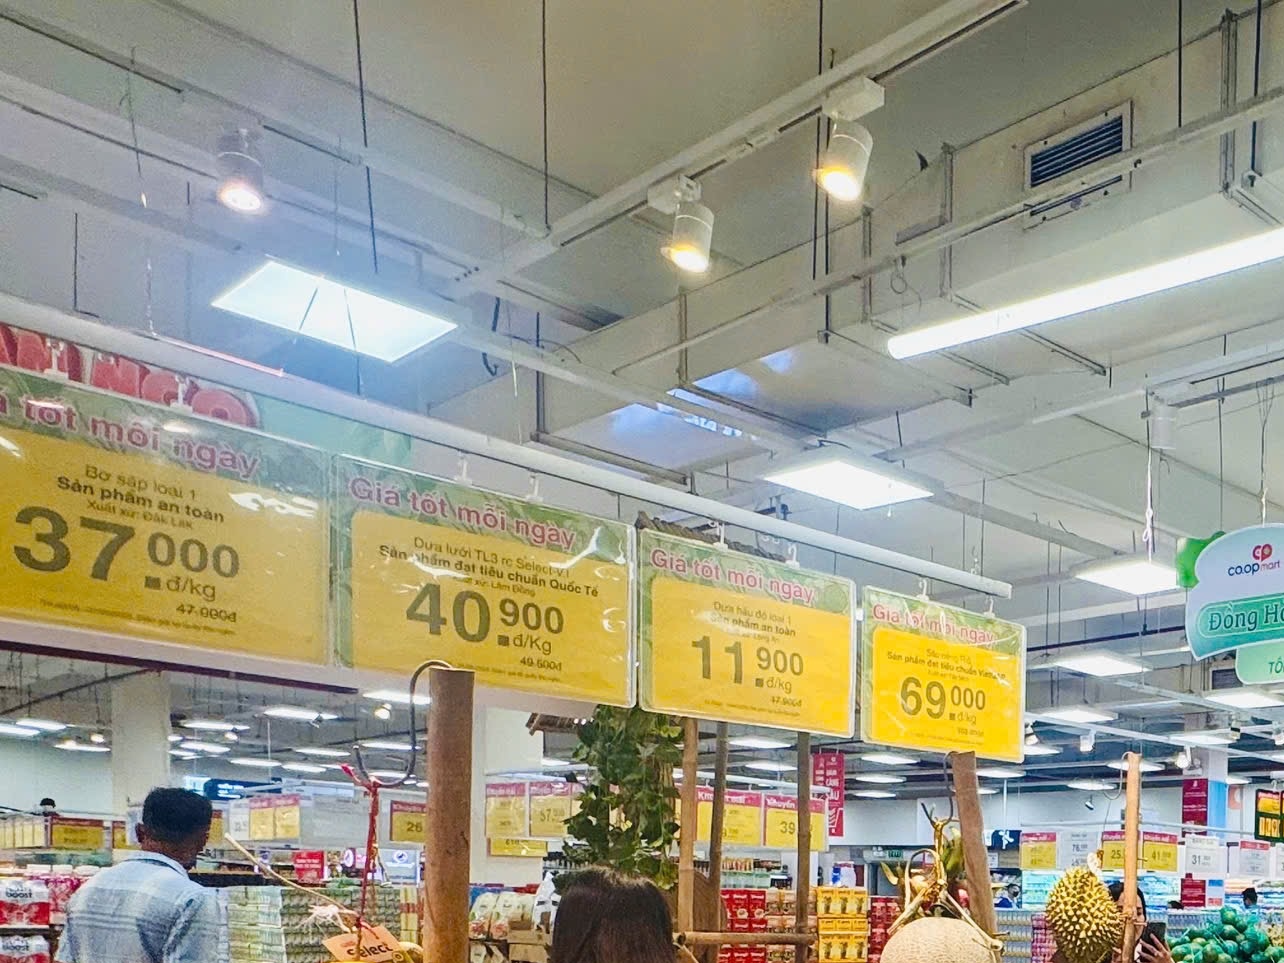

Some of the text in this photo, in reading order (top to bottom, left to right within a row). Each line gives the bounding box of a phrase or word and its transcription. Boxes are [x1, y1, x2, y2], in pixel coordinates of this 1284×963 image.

[57, 476, 95, 495] Sản
[158, 501, 181, 514] an
[186, 503, 225, 524] toàn
[350, 475, 402, 507] Giá
[409, 486, 449, 514] tốt
[652, 548, 687, 573] Giá
[166, 576, 217, 602] đ/kg
[454, 560, 478, 574] đạt
[480, 564, 505, 579] tiêu
[508, 569, 547, 587] chuẩn
[550, 578, 582, 595] Quốc
[1208, 601, 1258, 633] Đồng
[513, 634, 552, 656] đ/Kg
